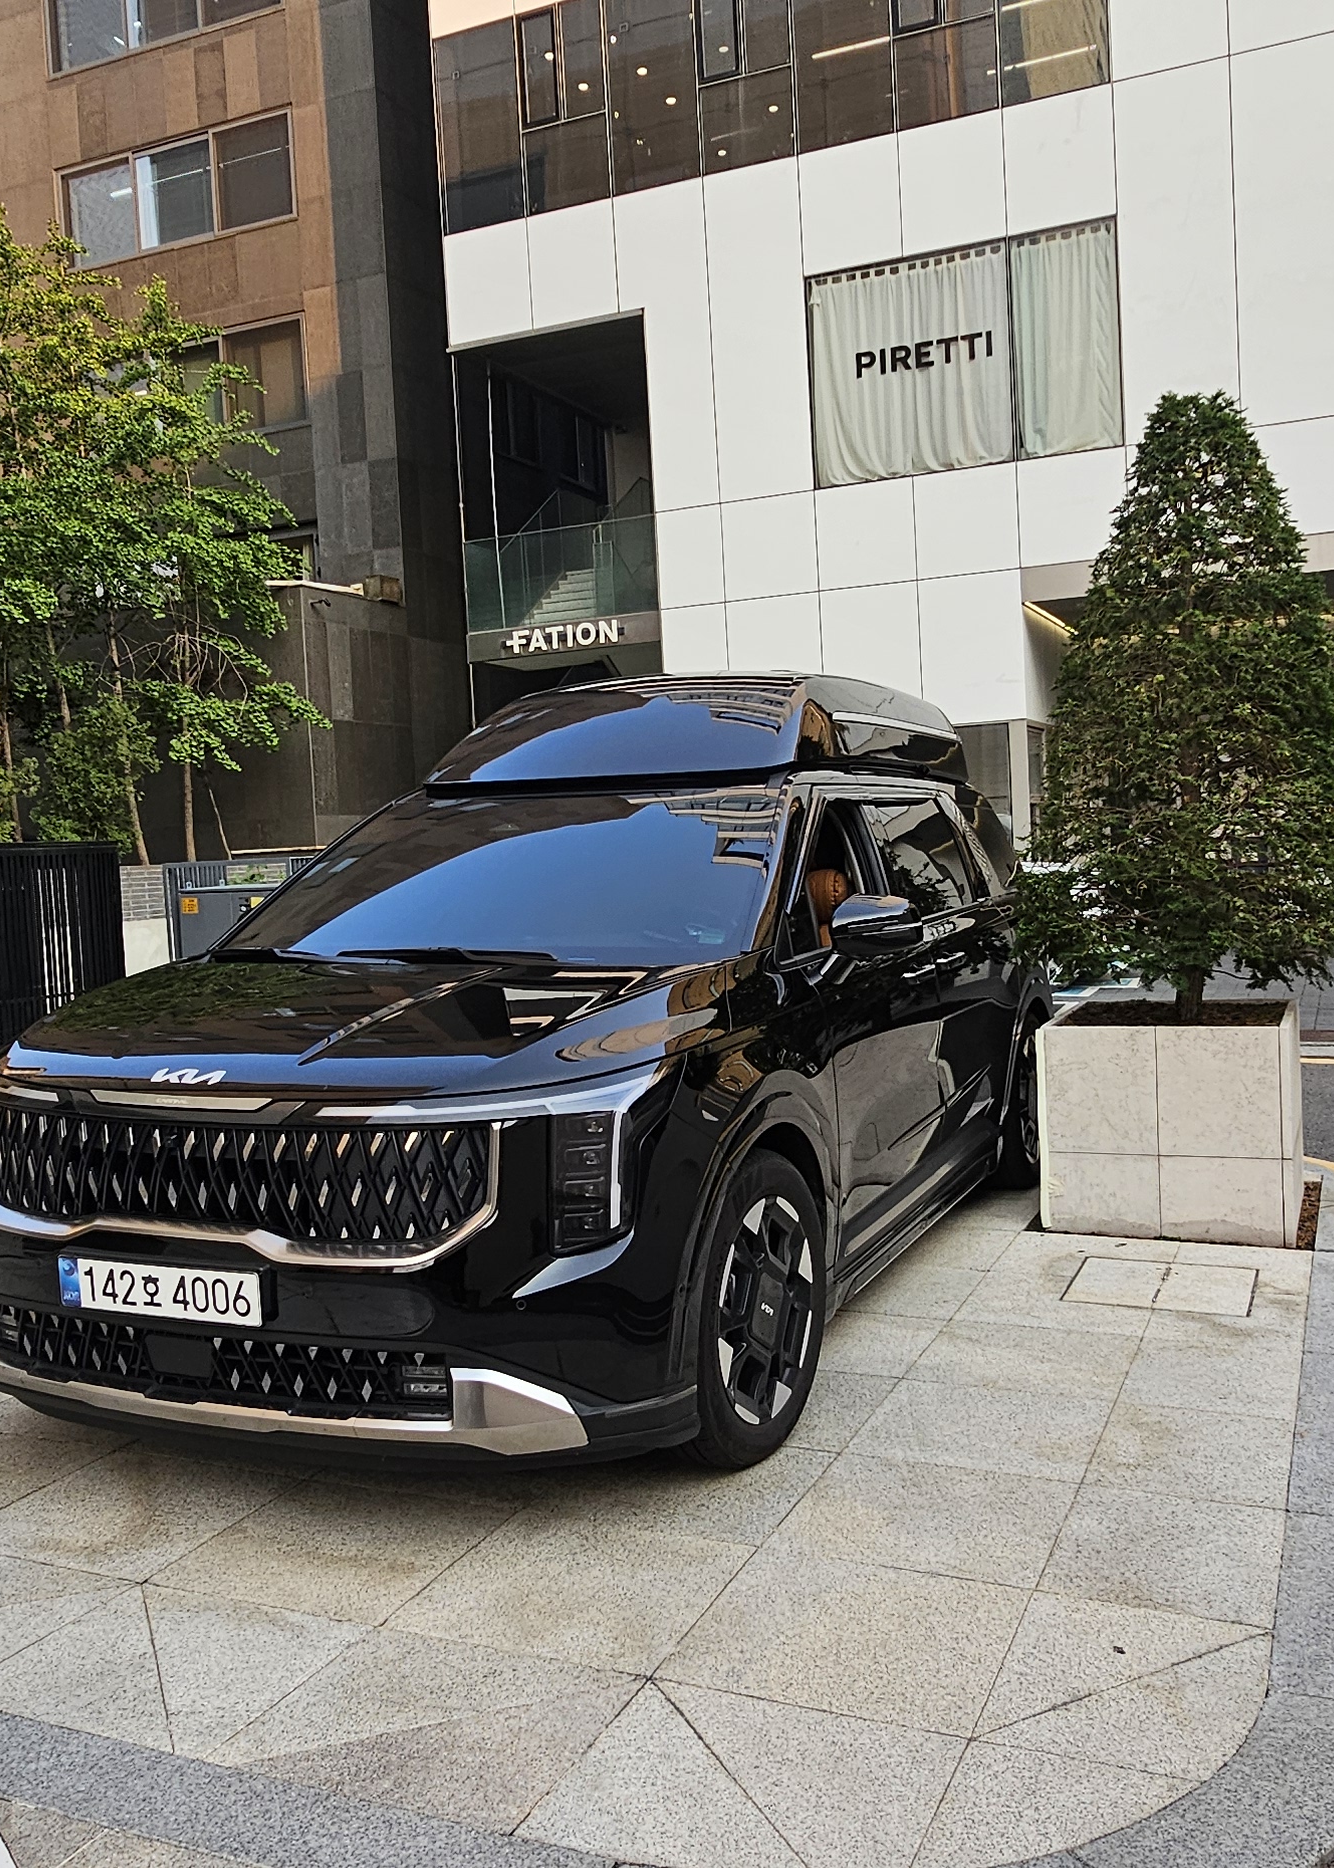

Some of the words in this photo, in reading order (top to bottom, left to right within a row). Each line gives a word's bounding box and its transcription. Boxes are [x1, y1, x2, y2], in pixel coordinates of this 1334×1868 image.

[855, 330, 993, 379] PIRETTI
[506, 619, 619, 654] FATION
[83, 1266, 162, 1308] 142호
[172, 1275, 251, 1317] 4006
